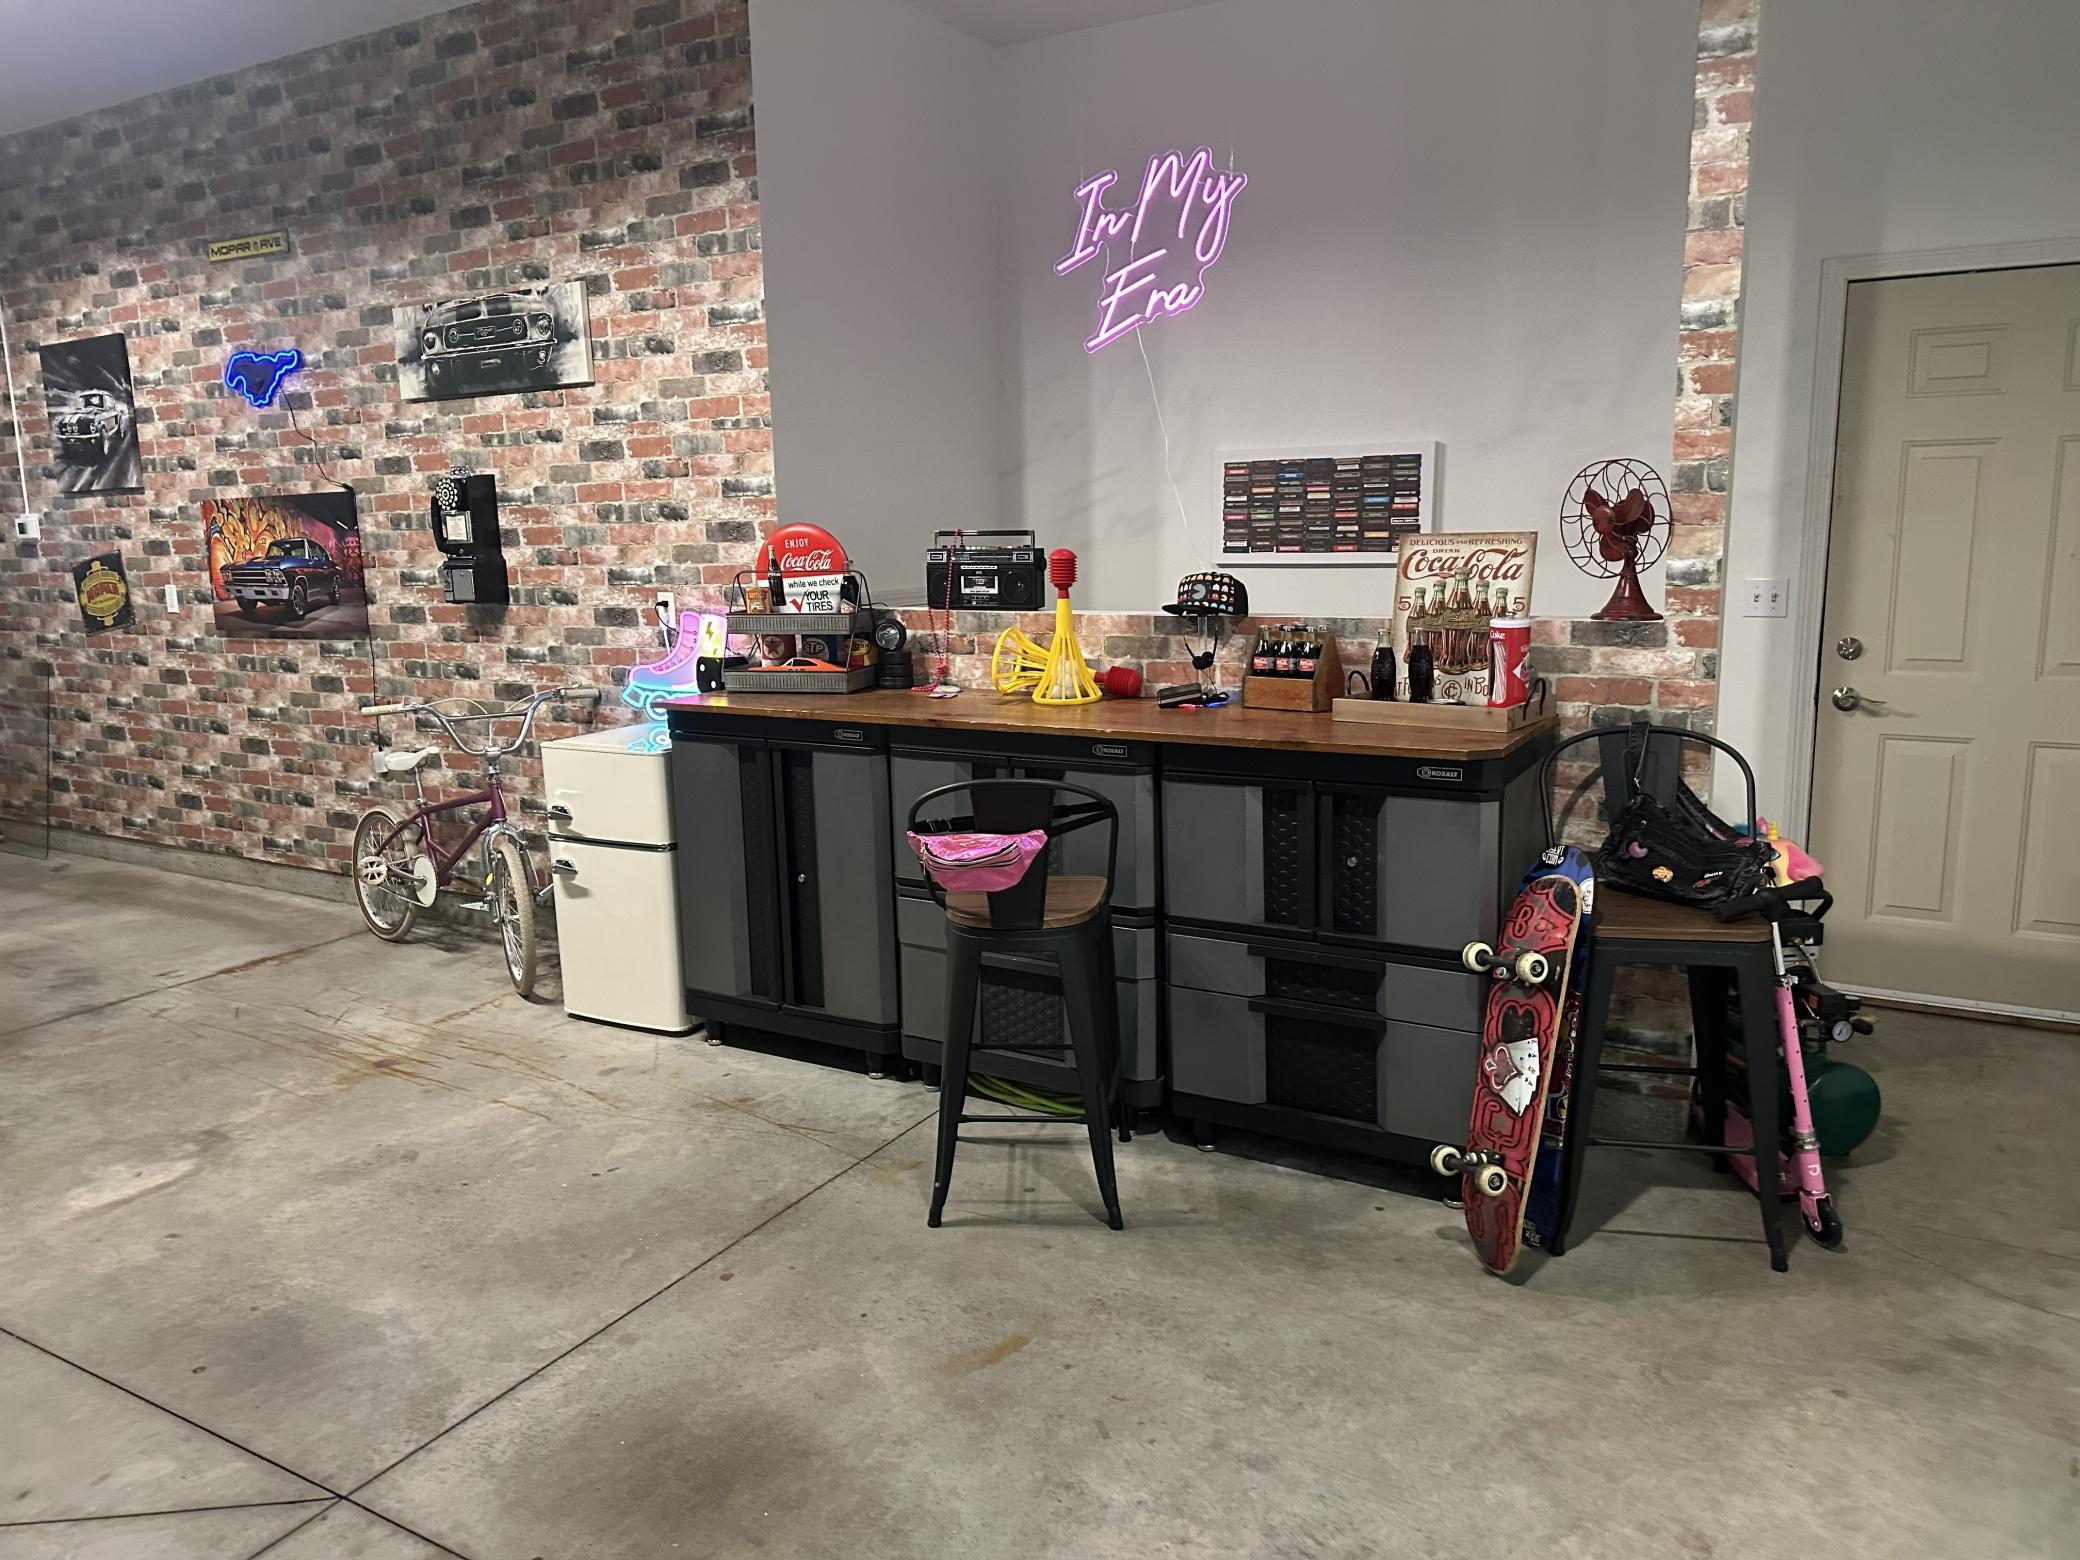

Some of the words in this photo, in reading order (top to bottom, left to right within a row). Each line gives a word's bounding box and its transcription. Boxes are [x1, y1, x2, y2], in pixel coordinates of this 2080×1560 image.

[1056, 173, 1131, 271] In
[1131, 151, 1243, 262] My
[210, 241, 252, 257] MOPAR
[259, 237, 282, 250] AVE
[1086, 248, 1201, 348] Era
[784, 538, 809, 549] ENJOY
[1409, 538, 1455, 546] DELICIOUS
[1468, 537, 1523, 545] REFRESHING
[780, 549, 834, 571] Coca-Cola
[1401, 548, 1529, 581] Coca-Cola
[787, 579, 806, 589] while
[818, 577, 840, 587] check
[804, 590, 830, 601] YOUR
[806, 601, 834, 612] TIRES
[1490, 630, 1506, 640] Coke
[804, 643, 824, 653] STP
[1464, 677, 1473, 692] IN
[1431, 770, 1459, 778] KOBALT
